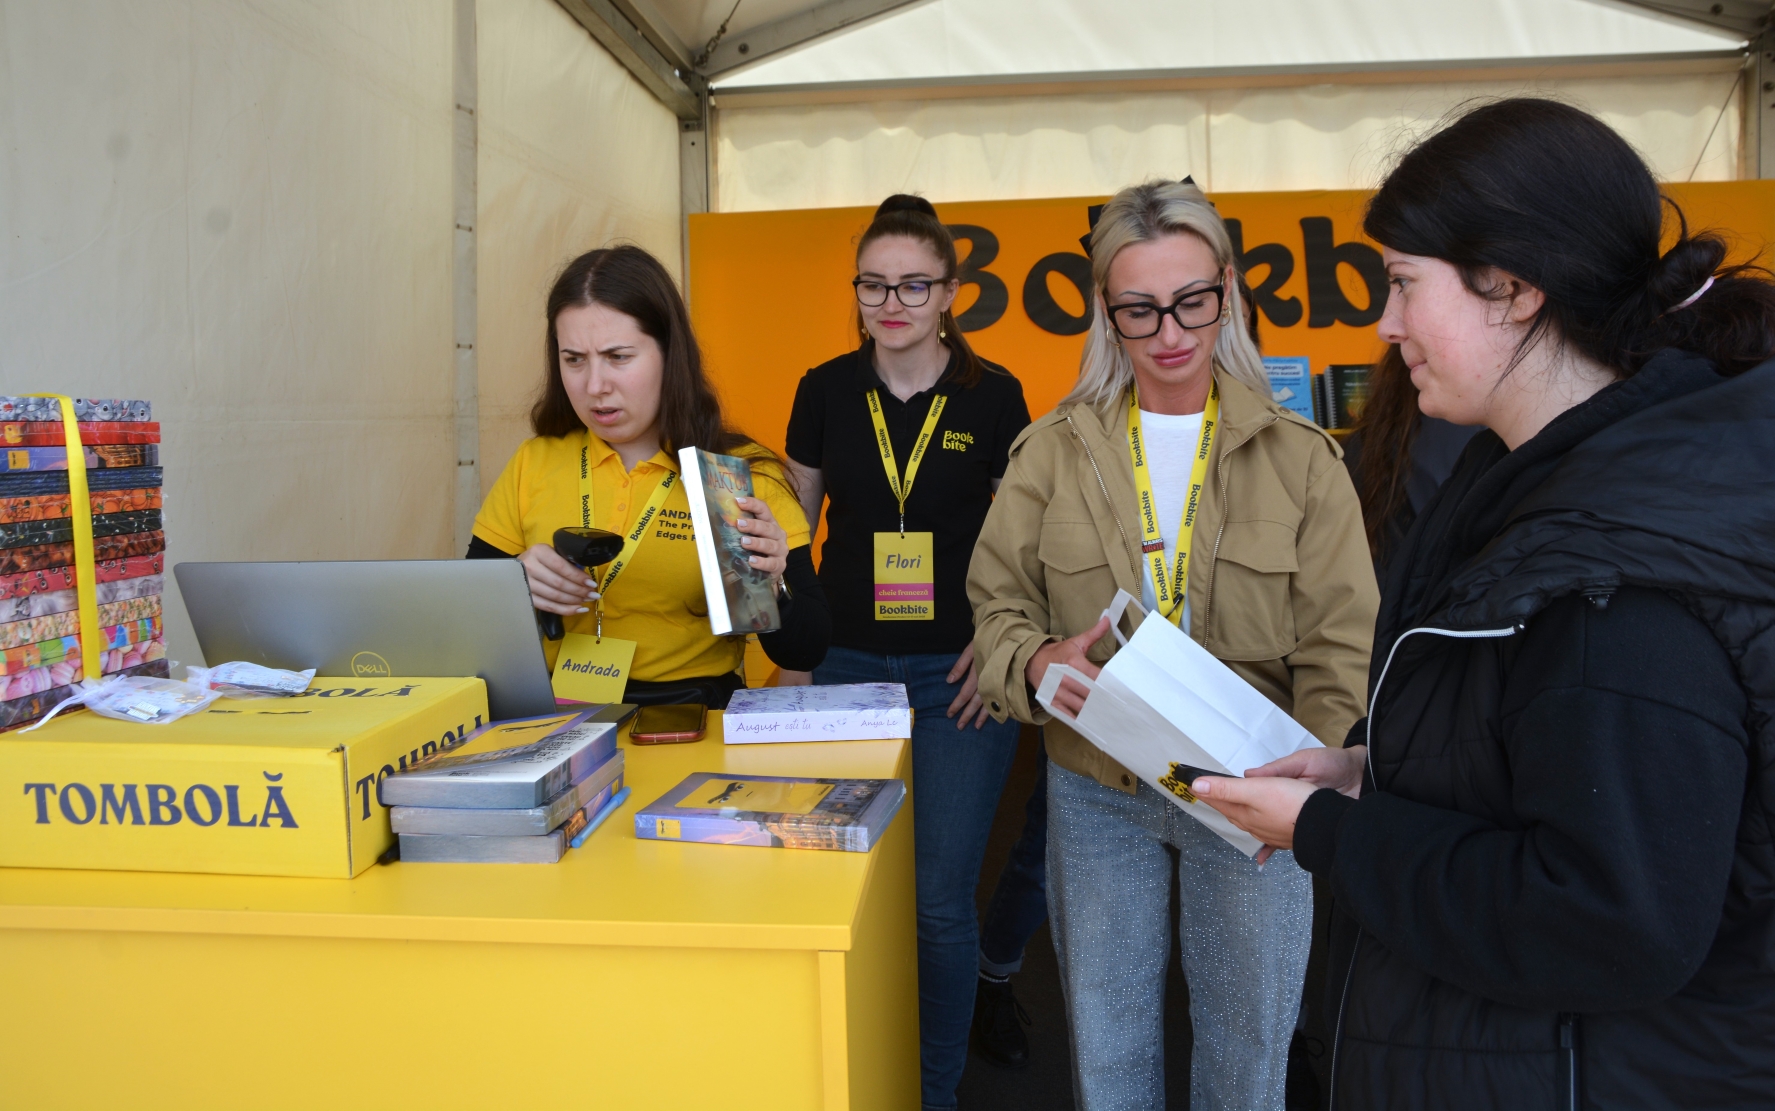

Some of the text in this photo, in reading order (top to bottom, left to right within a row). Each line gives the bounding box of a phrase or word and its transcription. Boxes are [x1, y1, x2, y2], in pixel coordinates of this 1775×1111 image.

[945, 215, 1388, 336] Bokb
[879, 428, 891, 459] Bookbite
[943, 439, 967, 452] bite
[944, 430, 974, 444] Book
[1131, 426, 1144, 468] Bookbite
[1199, 420, 1214, 460] Bookbite
[913, 433, 930, 463] Bookbite
[1142, 490, 1155, 533] Bookbite
[1185, 484, 1201, 527] Bookbite
[630, 506, 656, 541] Bookbite
[658, 520, 678, 529] The
[656, 530, 688, 541] Edges
[885, 553, 922, 569] Flori
[1154, 557, 1169, 602] Bookbite
[879, 604, 929, 615] Bookbite
[356, 664, 387, 674] DELL
[562, 658, 620, 678] Andrada
[290, 684, 422, 698] BOLĂ
[736, 721, 780, 734] August
[802, 718, 811, 730] tu
[860, 719, 885, 728] Anya
[24, 770, 299, 829] TOMBOLĂ
